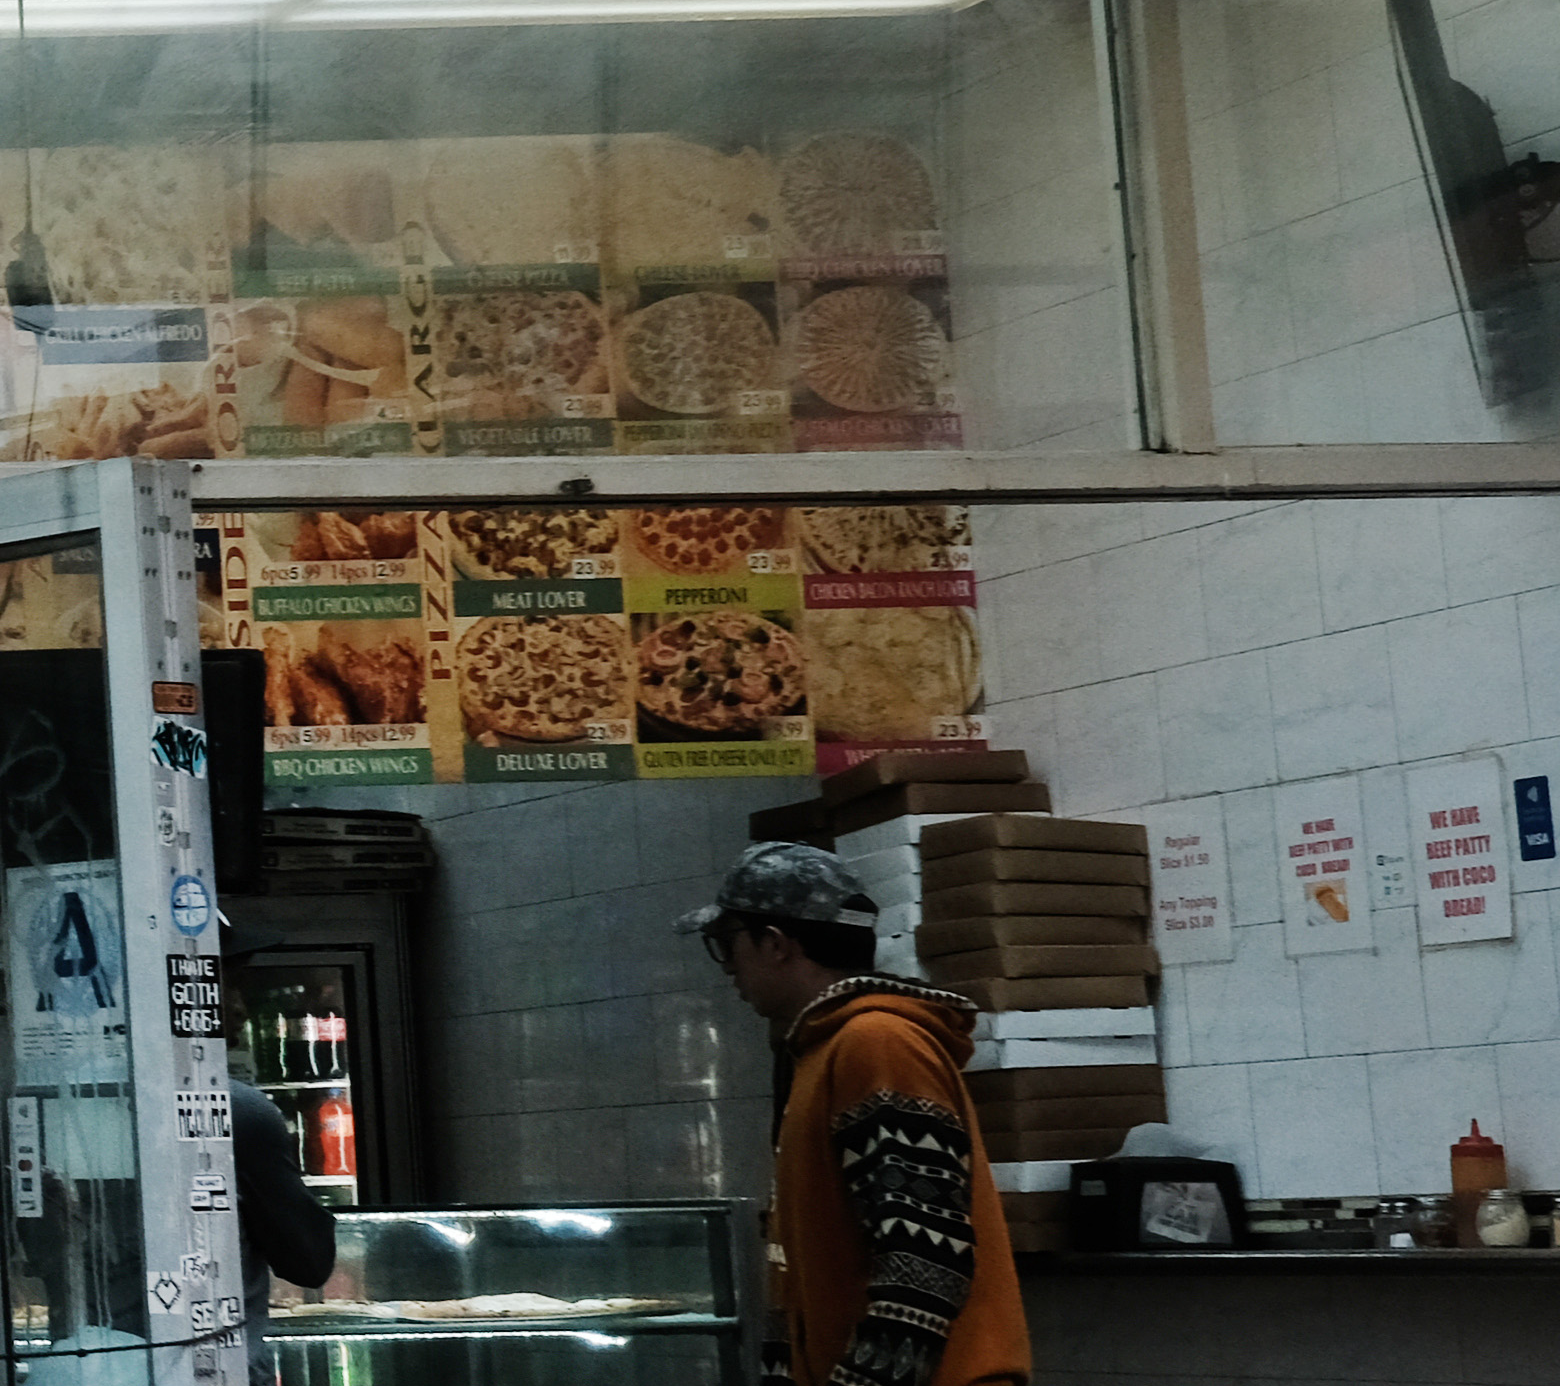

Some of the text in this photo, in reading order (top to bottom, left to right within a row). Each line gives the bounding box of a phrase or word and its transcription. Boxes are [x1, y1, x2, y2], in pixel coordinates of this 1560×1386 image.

[574, 560, 616, 577] 23.99
[371, 595, 417, 613] WINGS
[492, 591, 587, 609] MEAT LOVER
[665, 587, 748, 605] PEPPERONI
[274, 756, 418, 779] BBQ CHICKEN WINGS
[496, 752, 608, 772] DELUXE LOVER
[1429, 806, 1481, 830] WE HAVE
[1164, 834, 1201, 849] Regular
[1426, 835, 1491, 860] BEEF PATTY
[1525, 833, 1550, 846] VISA
[1160, 856, 1183, 870] Slice
[1428, 865, 1497, 890] WITH COCO
[1443, 896, 1486, 918] BREAD!
[1165, 917, 1188, 931] Slice
